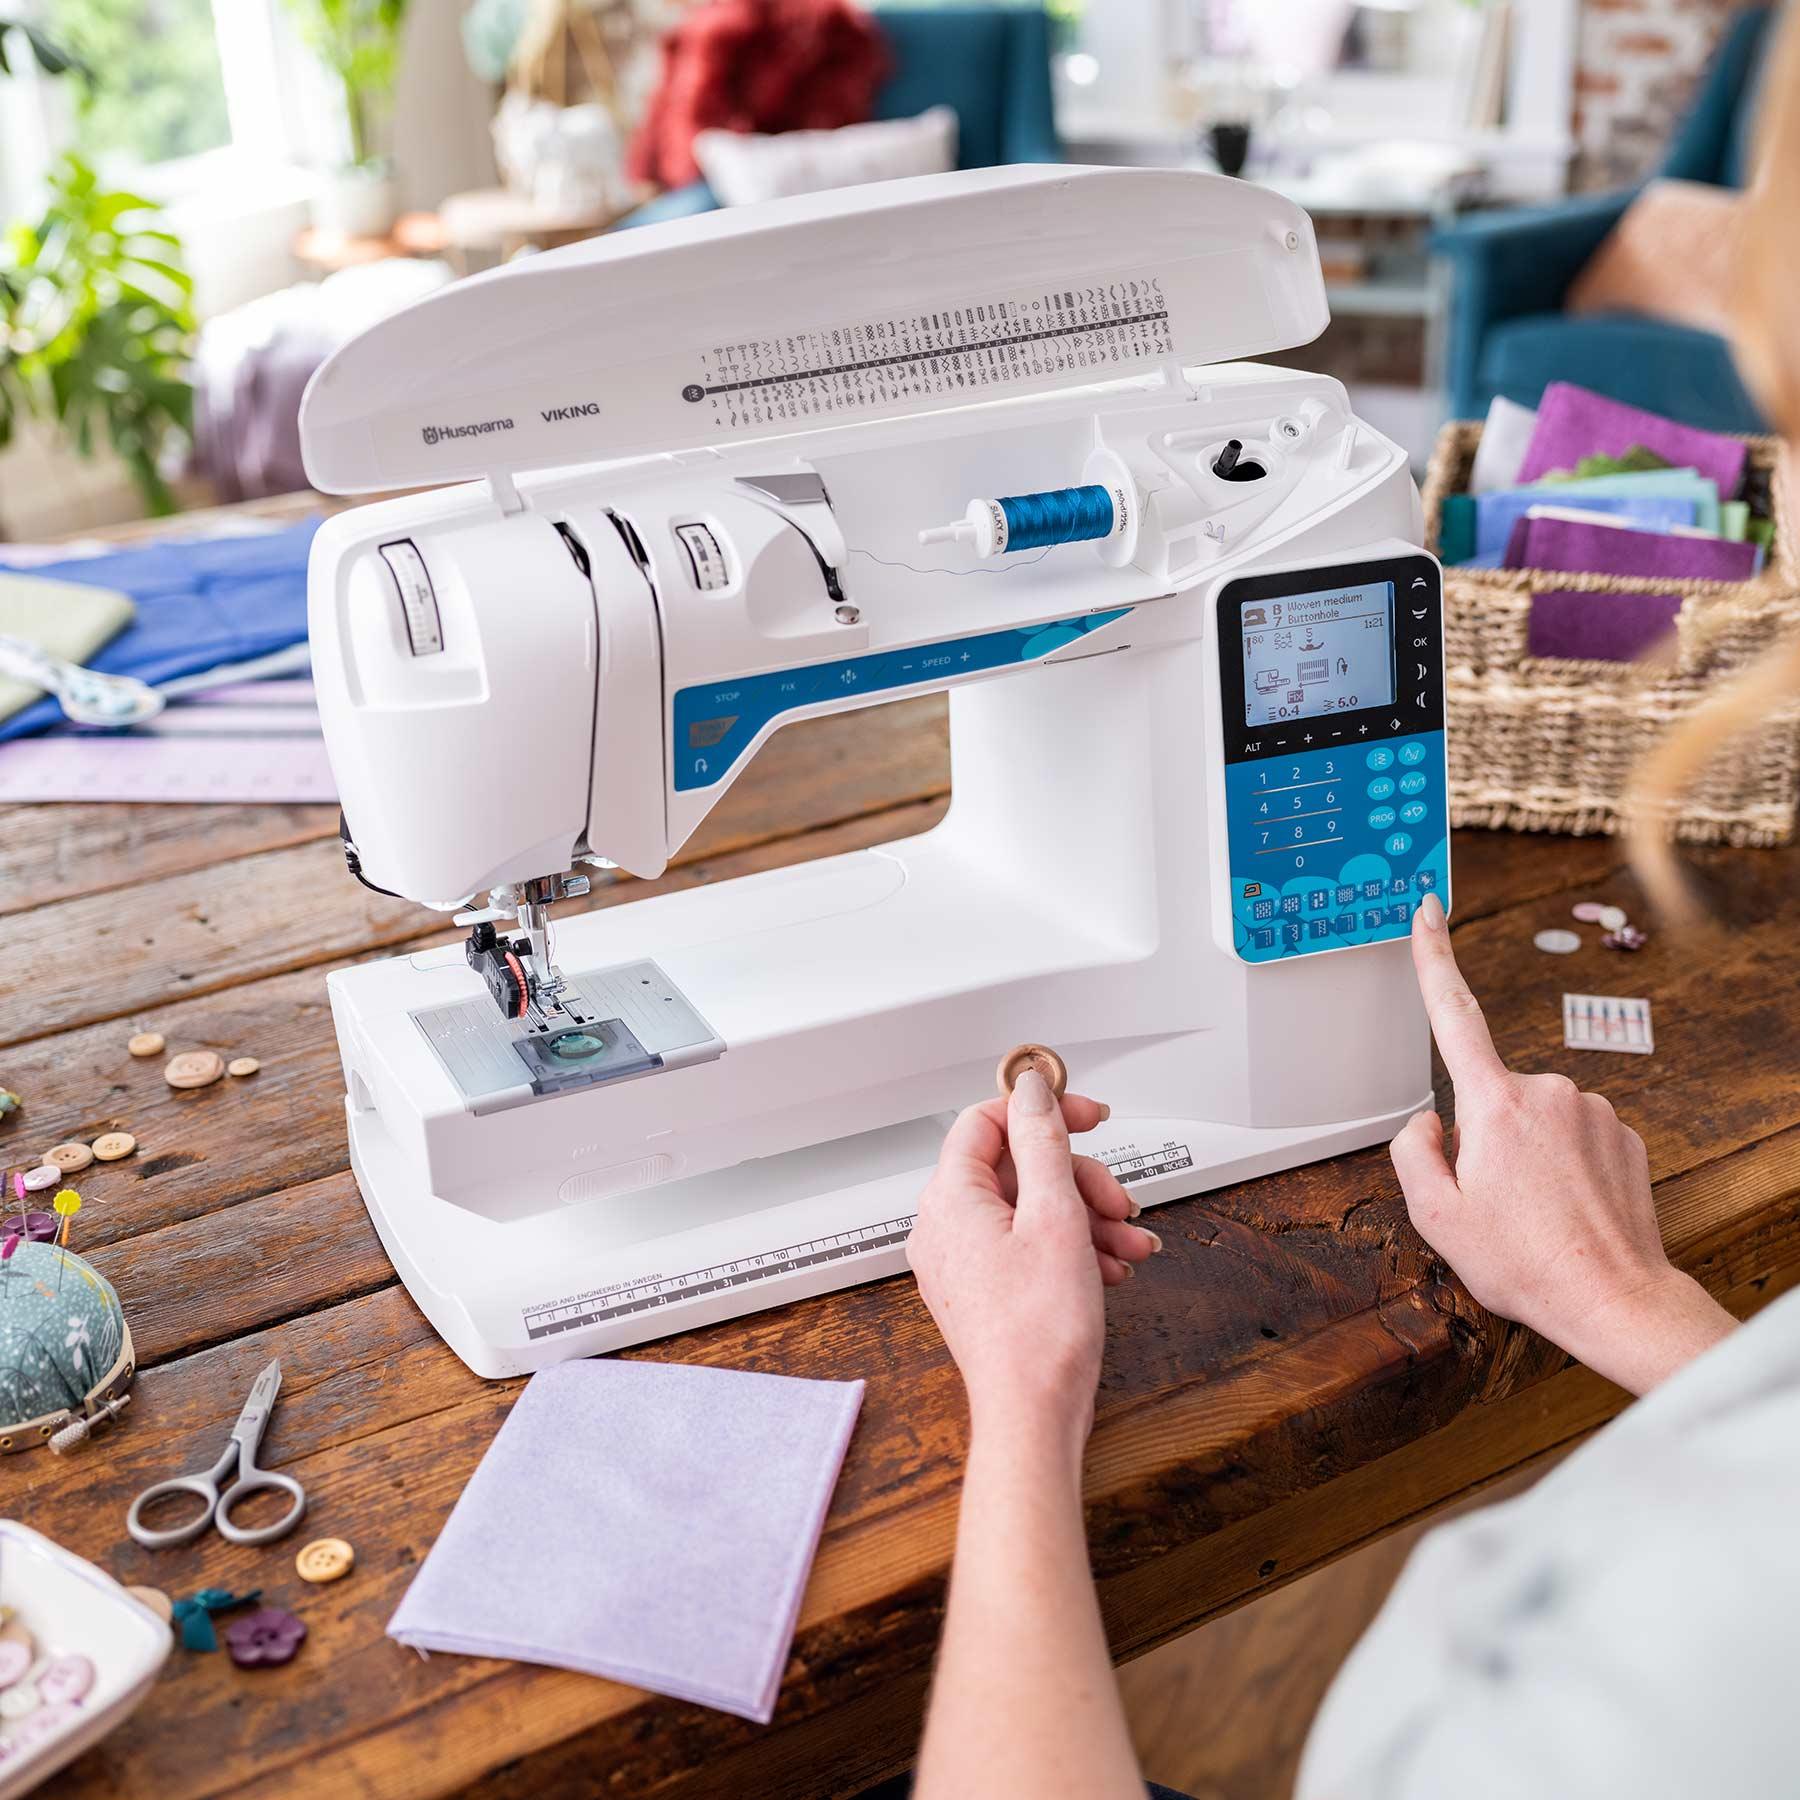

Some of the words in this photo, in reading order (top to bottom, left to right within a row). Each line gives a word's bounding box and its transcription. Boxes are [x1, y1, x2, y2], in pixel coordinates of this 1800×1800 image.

[705, 373, 711, 382] 2
[711, 399, 718, 408] 3
[439, 418, 514, 440] Husqvarna
[541, 403, 600, 422] VIKING
[991, 505, 1004, 531] SULKY
[1287, 602, 1321, 612] Woven
[1323, 593, 1363, 606] medium
[1272, 616, 1282, 627] 7
[1288, 609, 1340, 624] Buttonhole
[1364, 617, 1384, 629] 1:21
[1251, 635, 1264, 645] 80
[1413, 636, 1428, 647] OK
[921, 656, 951, 669] SPEED
[781, 683, 796, 692] FIX
[715, 692, 740, 703] STOP
[1279, 705, 1300, 717] 0.4
[1244, 743, 1262, 753] ALT
[1259, 773, 1268, 785] 1
[1292, 767, 1301, 779] 2
[1325, 762, 1334, 773] 3
[1373, 783, 1389, 793] CLR
[1259, 802, 1268, 813] 4
[1293, 797, 1302, 808] 5
[1326, 792, 1335, 803] 6
[1370, 812, 1394, 823] PROG
[1261, 832, 1269, 844] 7
[1294, 827, 1303, 838] 8
[1327, 821, 1336, 832] 9
[1295, 856, 1304, 867] 0
[1163, 1141, 1176, 1149] MM
[1132, 1161, 1142, 1169] 25
[1167, 1151, 1179, 1159] CM
[1144, 1168, 1154, 1177] 10
[1163, 1159, 1189, 1171] INCHES
[574, 1307, 579, 1315] 2
[601, 1299, 606, 1307] 3
[678, 1279, 684, 1287] 6
[730, 1265, 736, 1273] 8
[755, 1258, 761, 1266] 9
[775, 1252, 786, 1261] 10
[899, 1219, 910, 1229] 15
[658, 1296, 665, 1304] 2
[723, 1279, 730, 1287] 3
[787, 1262, 794, 1270] 4
[850, 1245, 857, 1253] 5
[521, 1301, 557, 1315] DESIGNED
[559, 1296, 575, 1304] AND
[577, 1284, 622, 1299] ENGINEERED
[632, 1273, 663, 1285] SWEDEN
